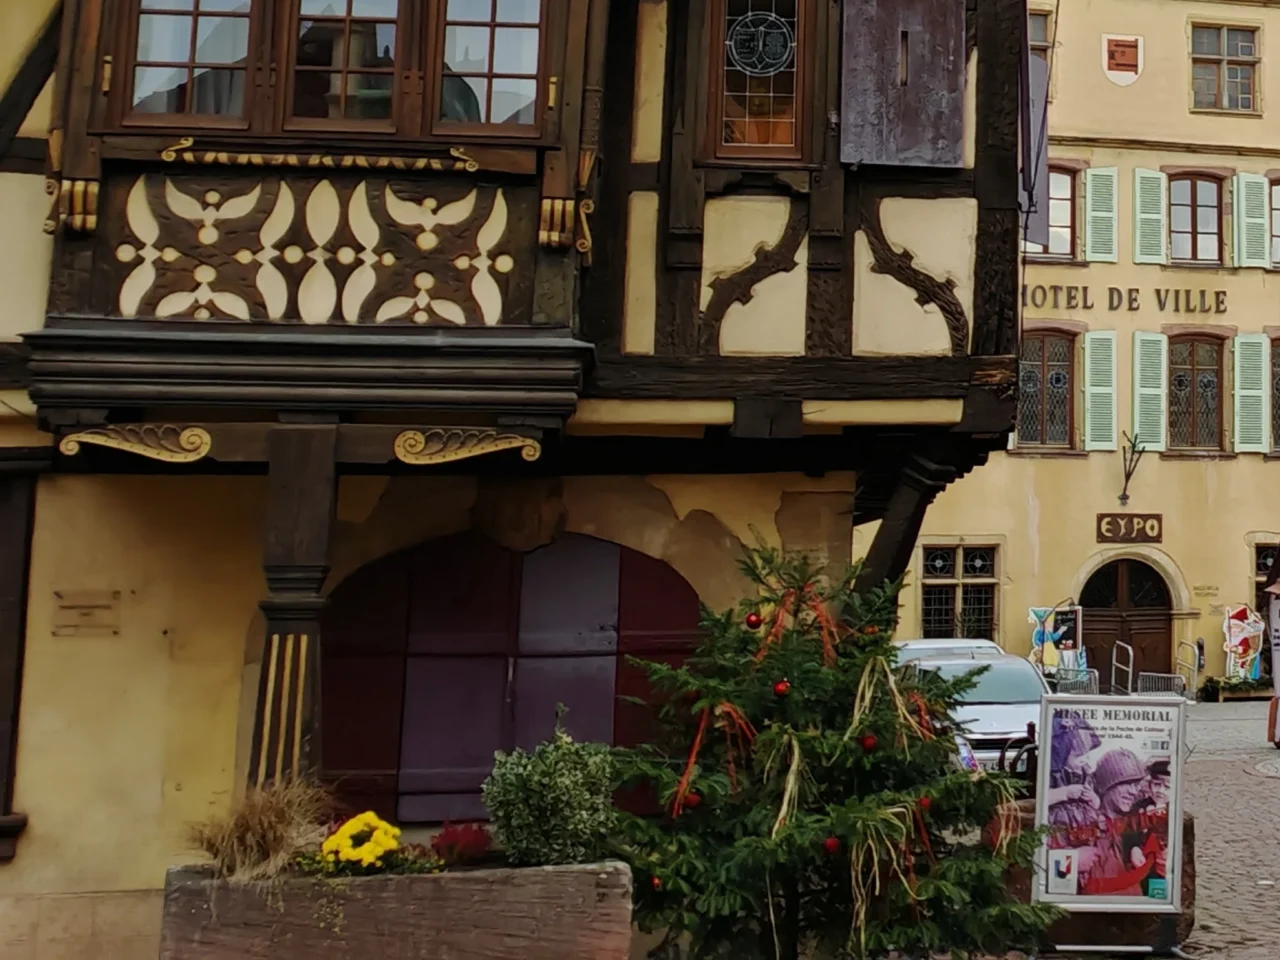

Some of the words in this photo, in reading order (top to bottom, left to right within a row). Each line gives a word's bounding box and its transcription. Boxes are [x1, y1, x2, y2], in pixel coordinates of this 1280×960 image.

[1108, 287, 1141, 312] DE
[1155, 288, 1228, 314] VILLE
[1103, 709, 1173, 722] MEMORIAL
